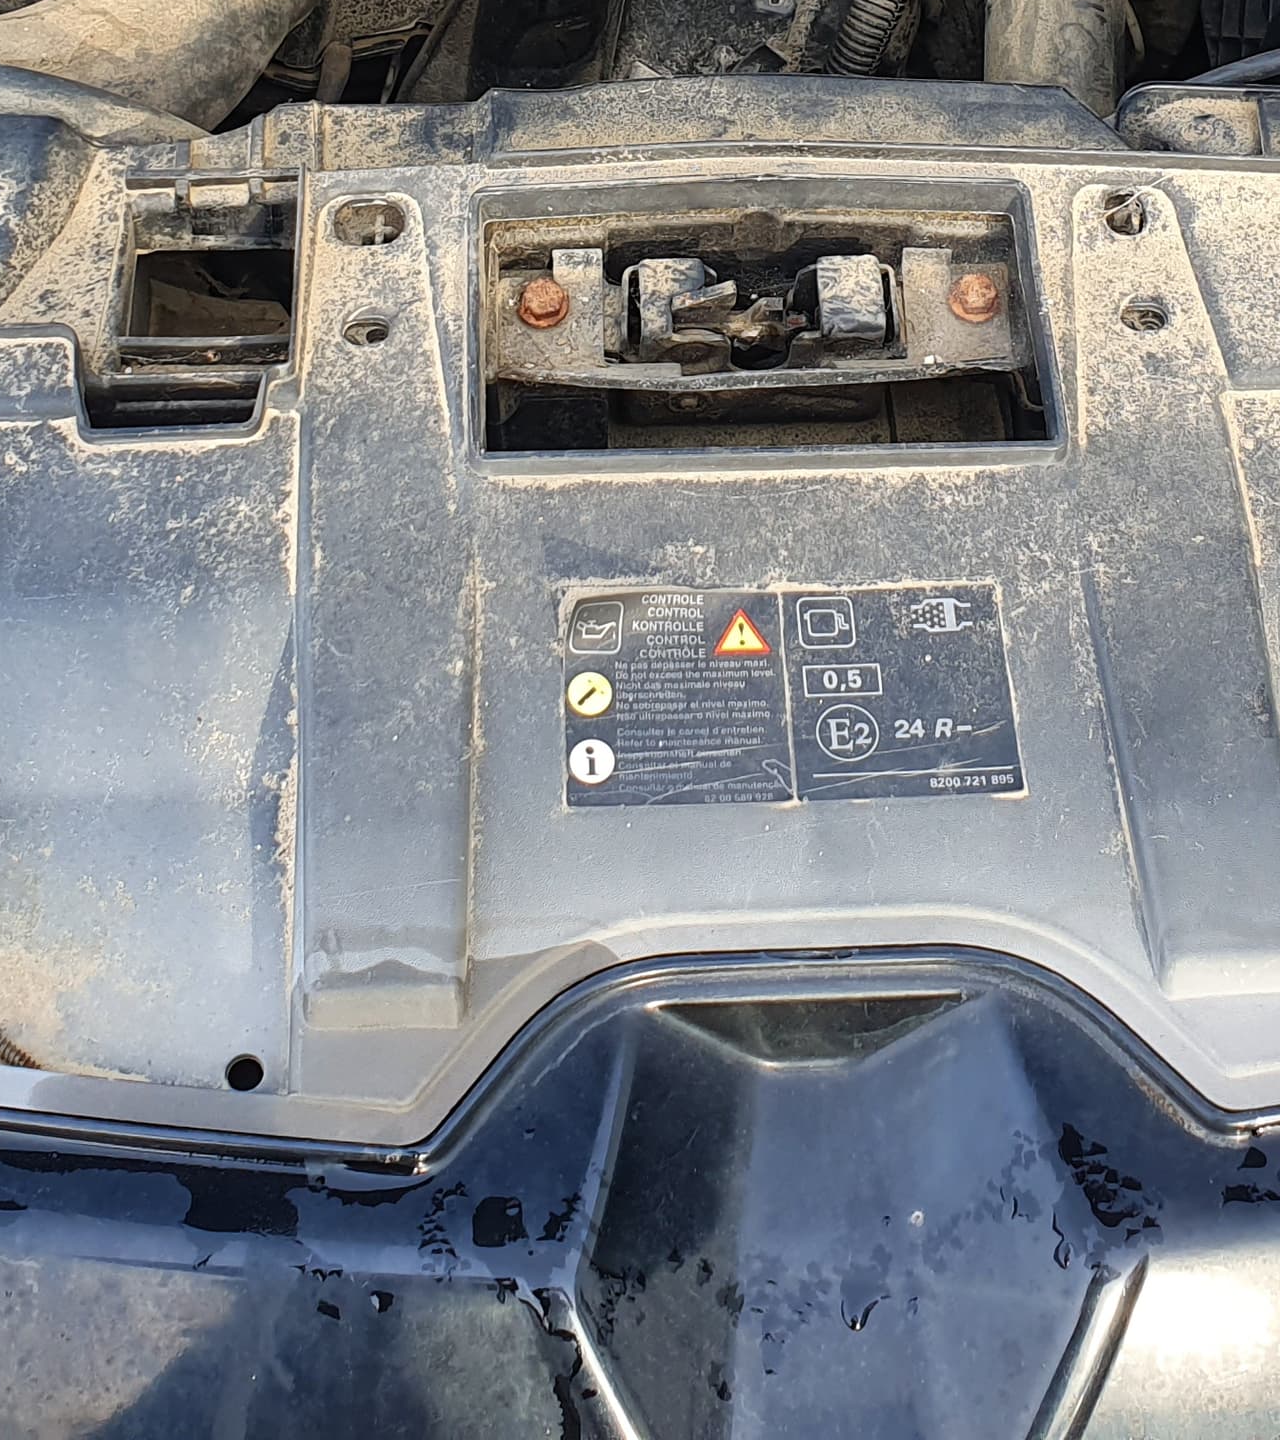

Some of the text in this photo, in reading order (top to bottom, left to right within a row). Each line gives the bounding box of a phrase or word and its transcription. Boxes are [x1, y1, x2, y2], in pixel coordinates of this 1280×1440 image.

[642, 594, 704, 605] CONTROLE
[647, 607, 704, 618] CONTROL
[632, 620, 704, 632] KONTROLLE
[646, 635, 706, 646] CONTROL
[631, 662, 648, 671] pas
[709, 660, 741, 668] niveau
[616, 671, 628, 679] Do
[631, 671, 647, 679] not
[649, 671, 682, 679] exceed
[686, 670, 701, 679] the
[702, 669, 749, 678] maximum
[616, 681, 641, 689] Nicht
[643, 681, 662, 689] das
[664, 680, 710, 689] maximale
[823, 669, 862, 691] 0,5
[616, 701, 630, 710] No
[690, 700, 699, 708] el
[701, 699, 725, 708] nivel
[617, 728, 664, 737] Consulter
[894, 719, 925, 738] 24
[826, 718, 872, 752] E2
[617, 738, 643, 747] Refer
[646, 738, 656, 746] to
[720, 760, 732, 768] de
[929, 774, 1014, 787] 8200 721 895
